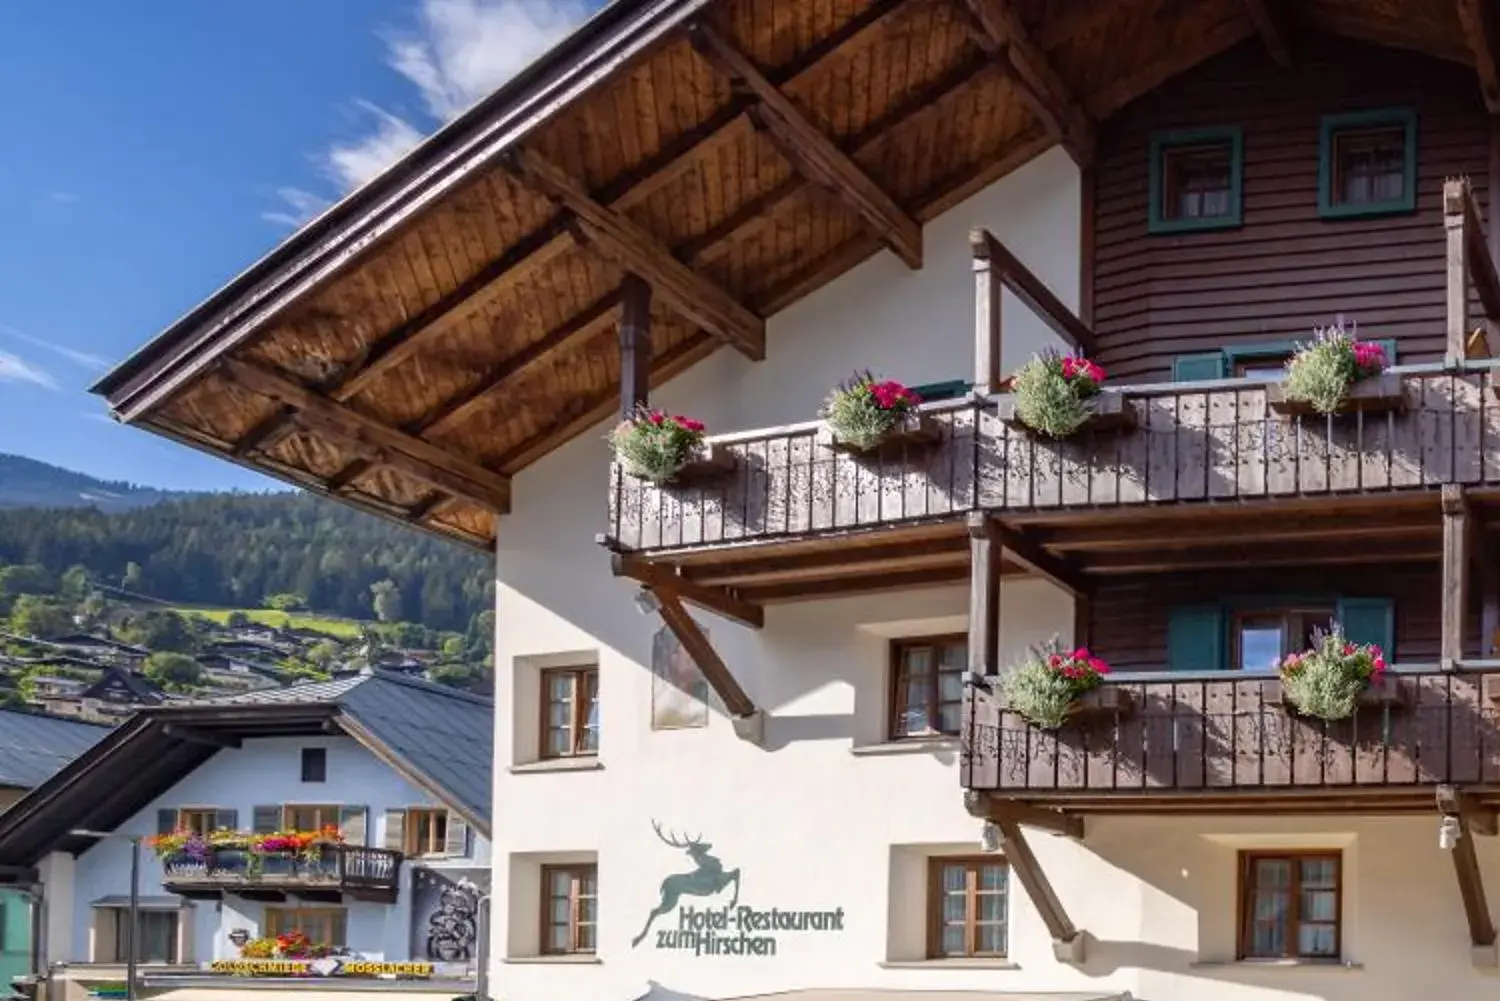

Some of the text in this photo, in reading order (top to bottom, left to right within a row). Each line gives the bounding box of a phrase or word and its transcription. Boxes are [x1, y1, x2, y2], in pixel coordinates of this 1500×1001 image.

[679, 905, 845, 931] Hotel-Restaurant
[656, 930, 777, 957] zum Hirschen
